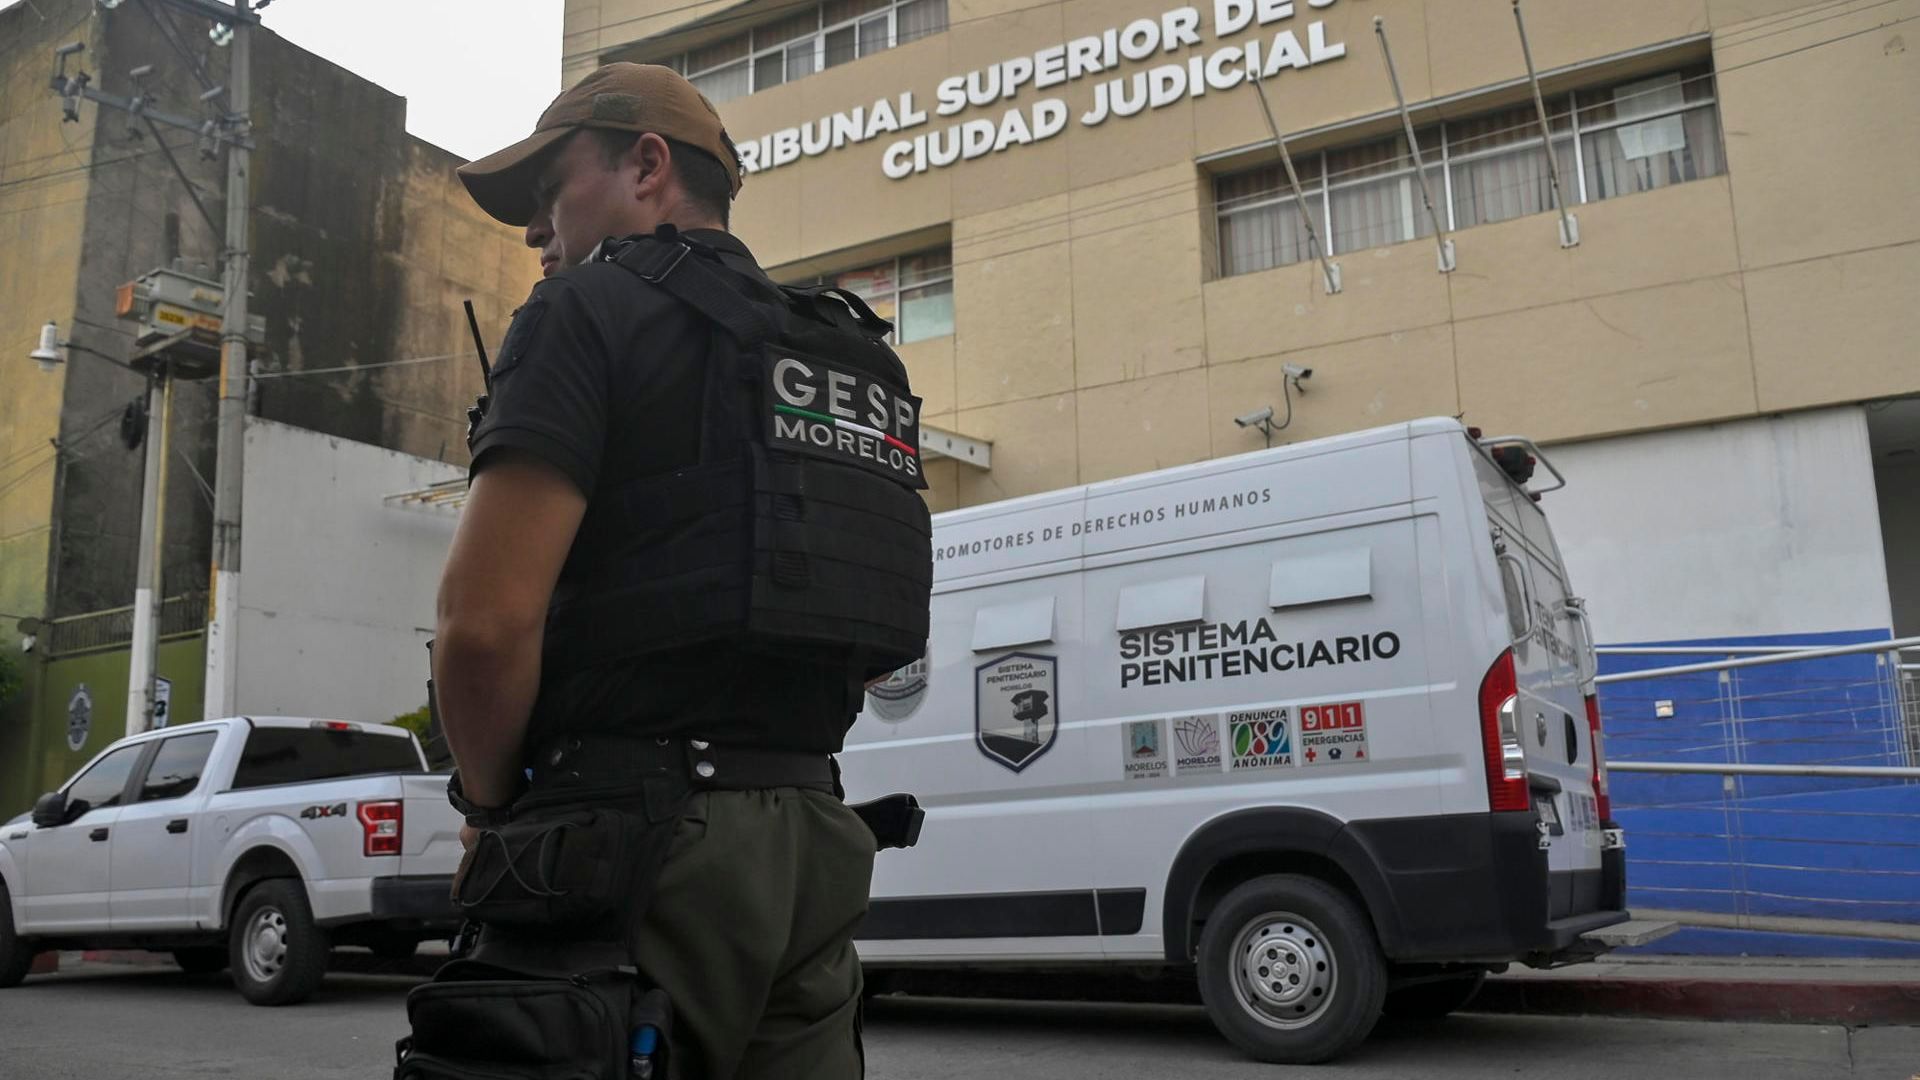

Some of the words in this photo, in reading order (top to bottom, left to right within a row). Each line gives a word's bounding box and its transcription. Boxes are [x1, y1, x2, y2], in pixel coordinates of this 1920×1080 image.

[736, 91, 928, 173] RIBUNAL
[936, 6, 1200, 117] SUPERIOR
[1214, 0, 1295, 37] DE
[882, 99, 1067, 179] CIUDAD
[1081, 20, 1346, 127] JUDICIAL
[773, 358, 915, 438] GESP
[774, 415, 918, 476] MORELOS
[936, 531, 1034, 560] ROMOTORES
[1043, 526, 1063, 541] DE
[1072, 508, 1165, 536] DERECHOS
[1175, 488, 1272, 518] HUMANOS
[1119, 617, 1277, 660] SISTEMA
[1120, 631, 1400, 688] PENITENCIARIO
[1230, 710, 1287, 722] DENUNCIA
[1304, 706, 1356, 729] 911
[1177, 756, 1220, 765] MORELOS
[1232, 720, 1288, 758] 089
[1303, 734, 1365, 746] EMERGENCIAS
[1125, 761, 1167, 771] MORELOS
